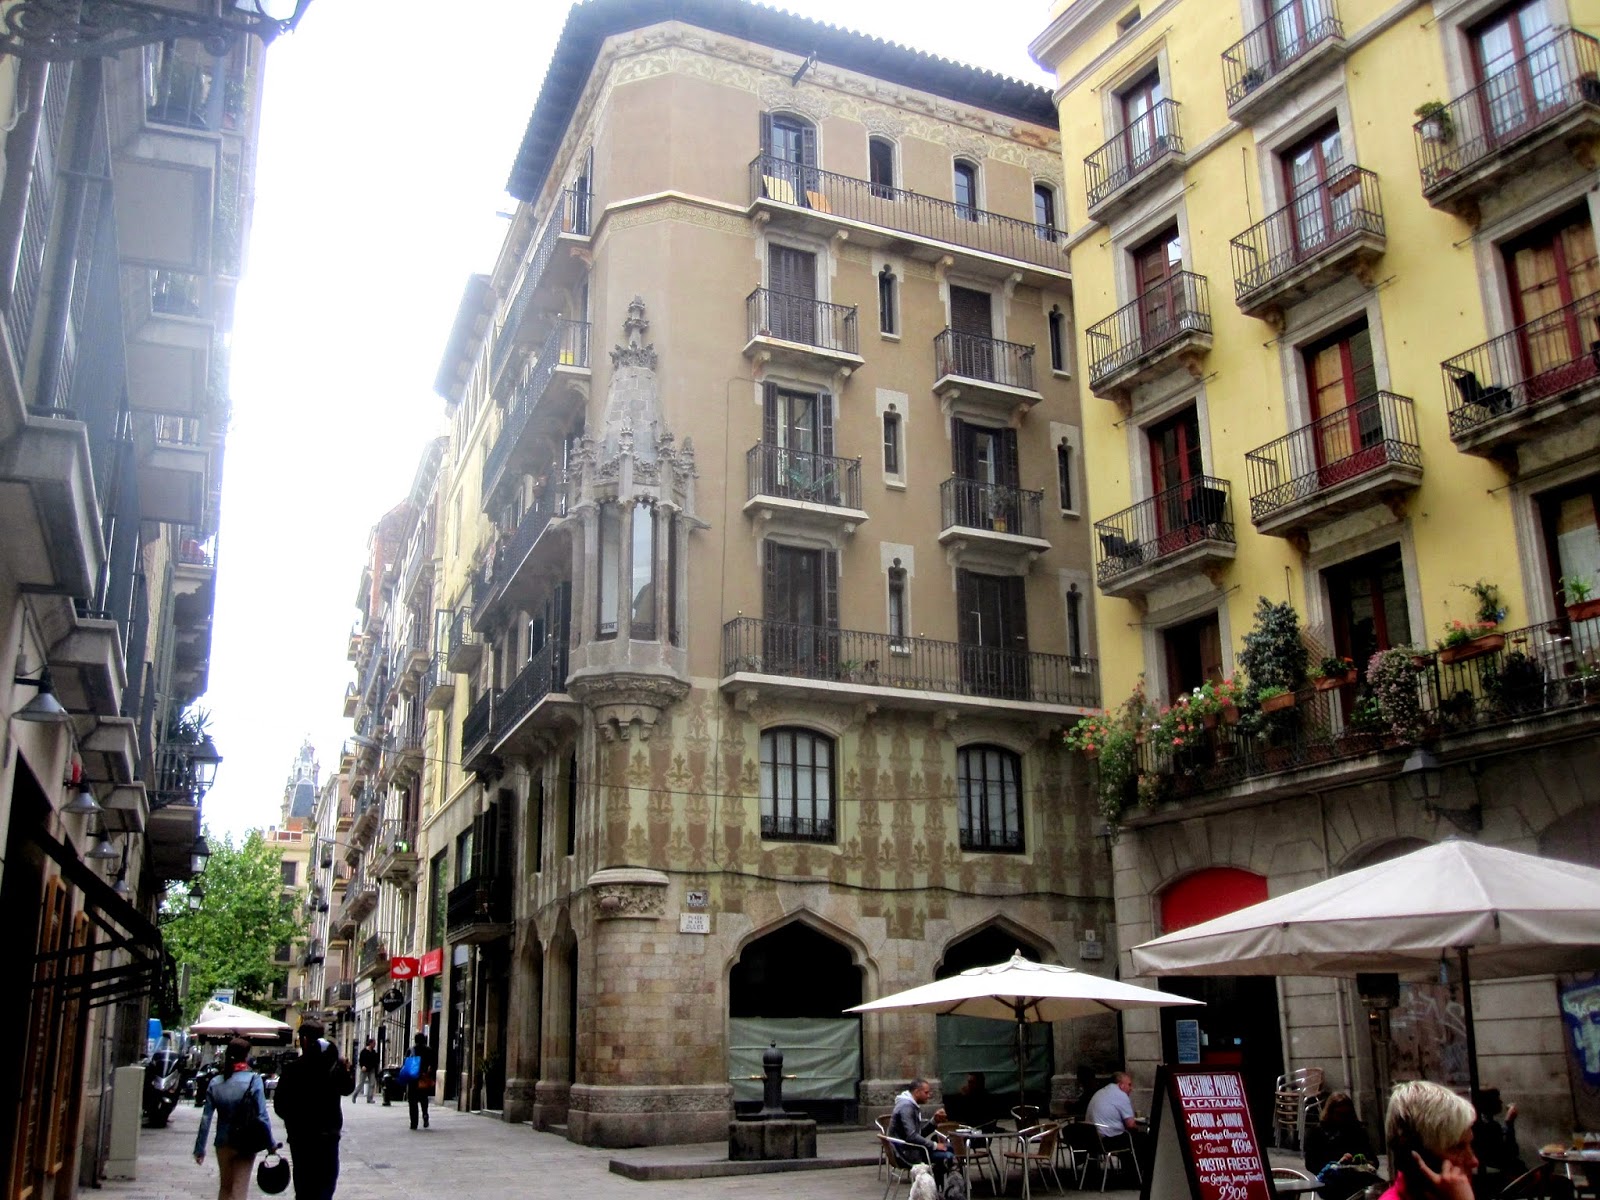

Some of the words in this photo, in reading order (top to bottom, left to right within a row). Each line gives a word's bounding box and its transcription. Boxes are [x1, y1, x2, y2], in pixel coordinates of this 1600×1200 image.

[1182, 1100, 1197, 1108] LA
[1197, 1100, 1245, 1108] CATALANA
[1199, 1157, 1227, 1172] PASTA
[1226, 1157, 1260, 1170] FRESCA
